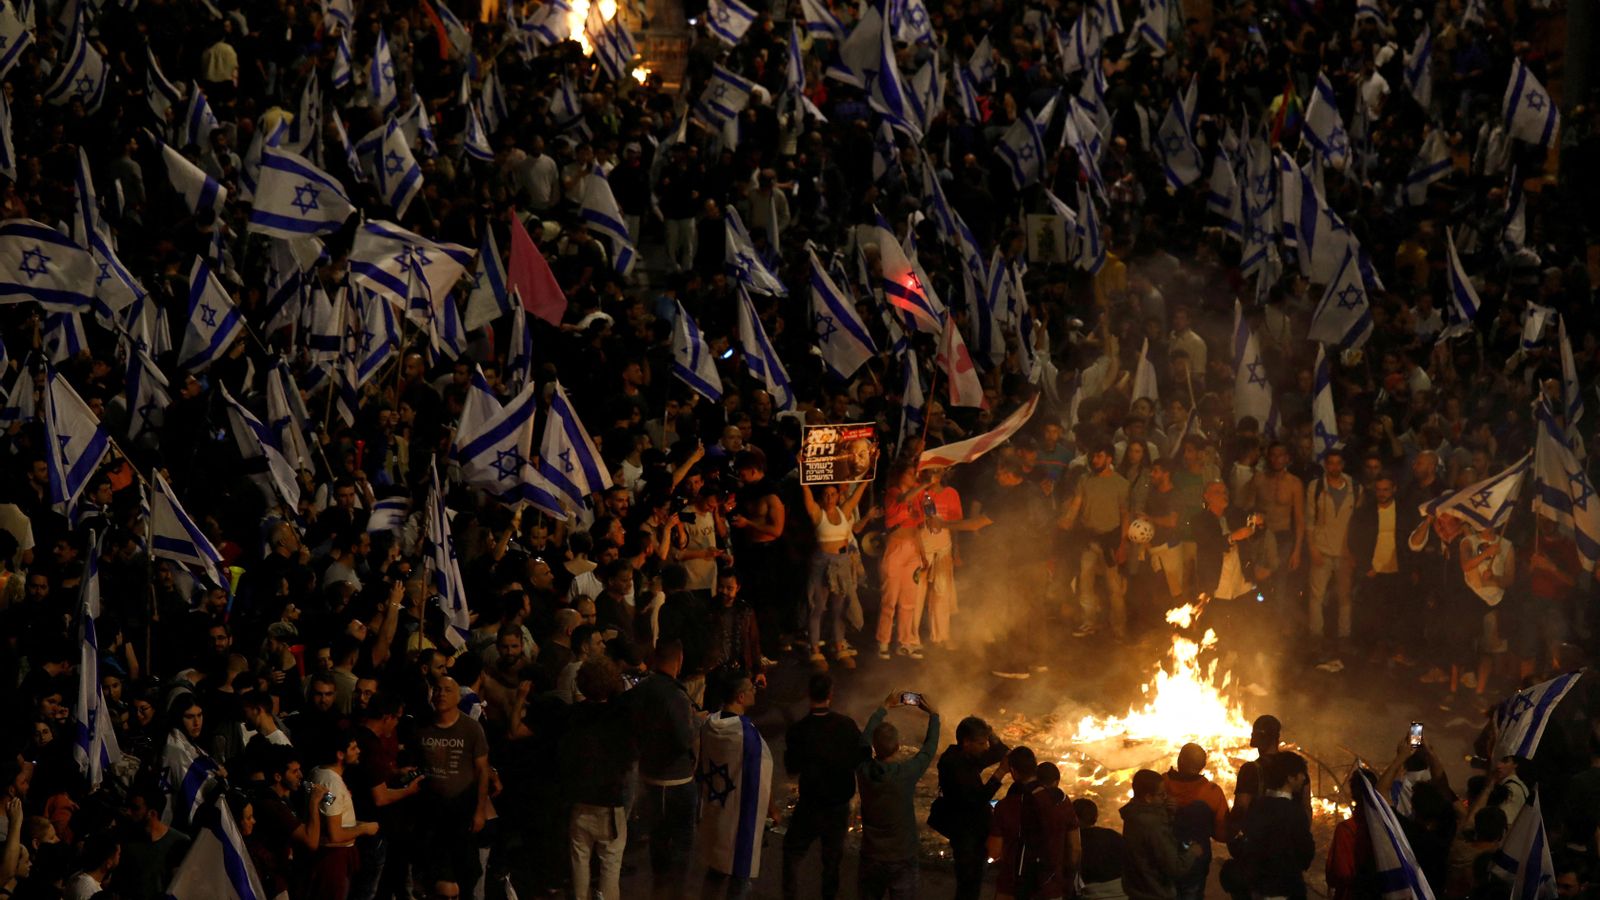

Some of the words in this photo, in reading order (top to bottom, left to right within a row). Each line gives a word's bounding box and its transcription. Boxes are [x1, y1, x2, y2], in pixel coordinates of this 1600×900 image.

[808, 428, 836, 443] לא
[807, 442, 835, 457] ניתן
[422, 737, 464, 748] LONDON
